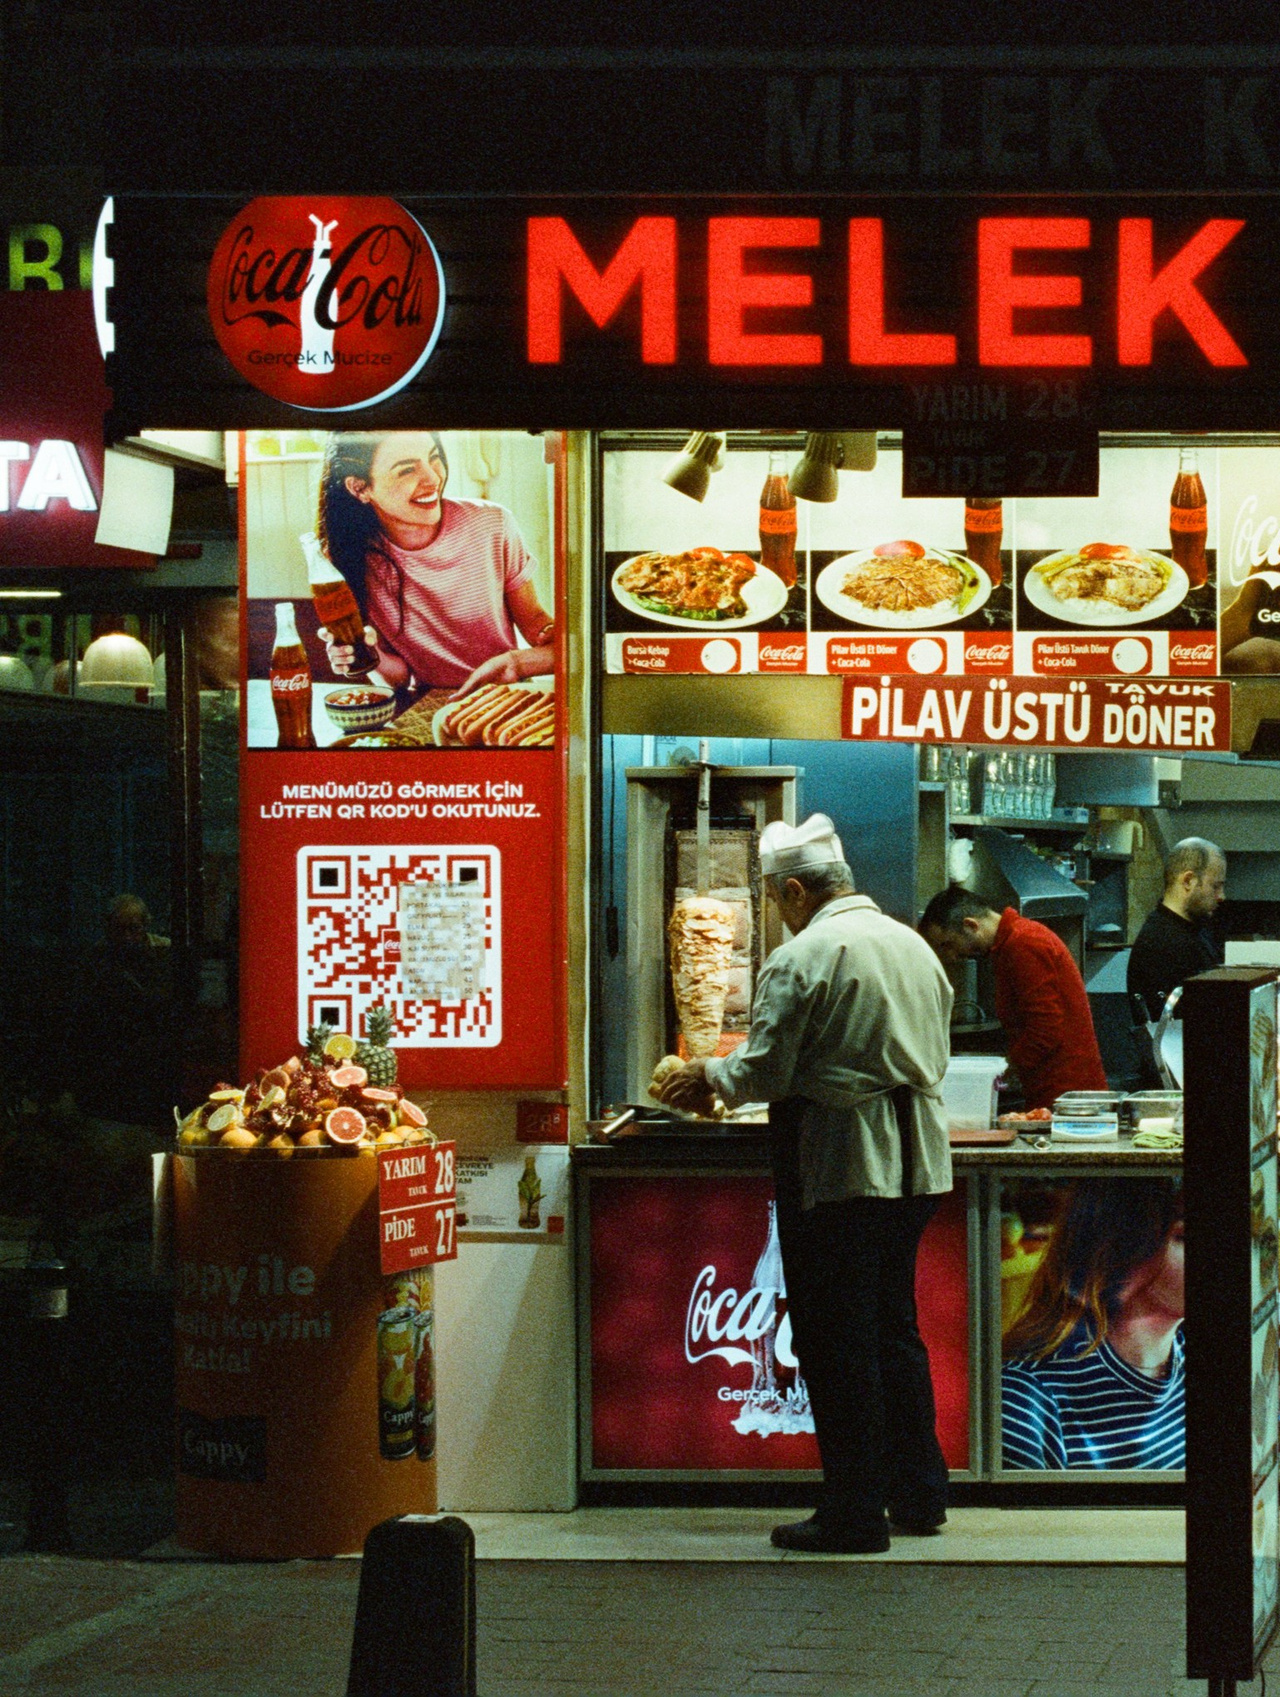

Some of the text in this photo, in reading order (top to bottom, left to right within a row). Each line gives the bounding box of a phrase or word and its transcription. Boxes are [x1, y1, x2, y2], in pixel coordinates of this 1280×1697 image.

[766, 73, 1115, 174] MELEK
[222, 224, 423, 331] Coca-Cola
[527, 216, 1250, 367] MELEK
[248, 350, 393, 367] Gerçek Mucize
[1022, 450, 1077, 488] 27
[760, 645, 806, 661] Coca-Cola
[837, 657, 871, 668] Coca-Cola
[965, 644, 1012, 661] Coca-Cola
[1043, 657, 1077, 668] Coca-Cola
[1170, 644, 1216, 660] Coca-Cola
[1105, 683, 1215, 697] TAVUK
[852, 675, 1091, 743] PİLAV ÜSTÜ
[1104, 695, 1215, 747] DÖNER
[282, 780, 523, 802] MENÜMÜZÜ GÖRMEK İÇİN
[260, 801, 541, 820] LÜTFEN QR KOD'U OKUTUNUZ.
[383, 1150, 454, 1194] YARIM 28
[384, 1208, 455, 1256] PİDE 27
[258, 1253, 316, 1296] ile
